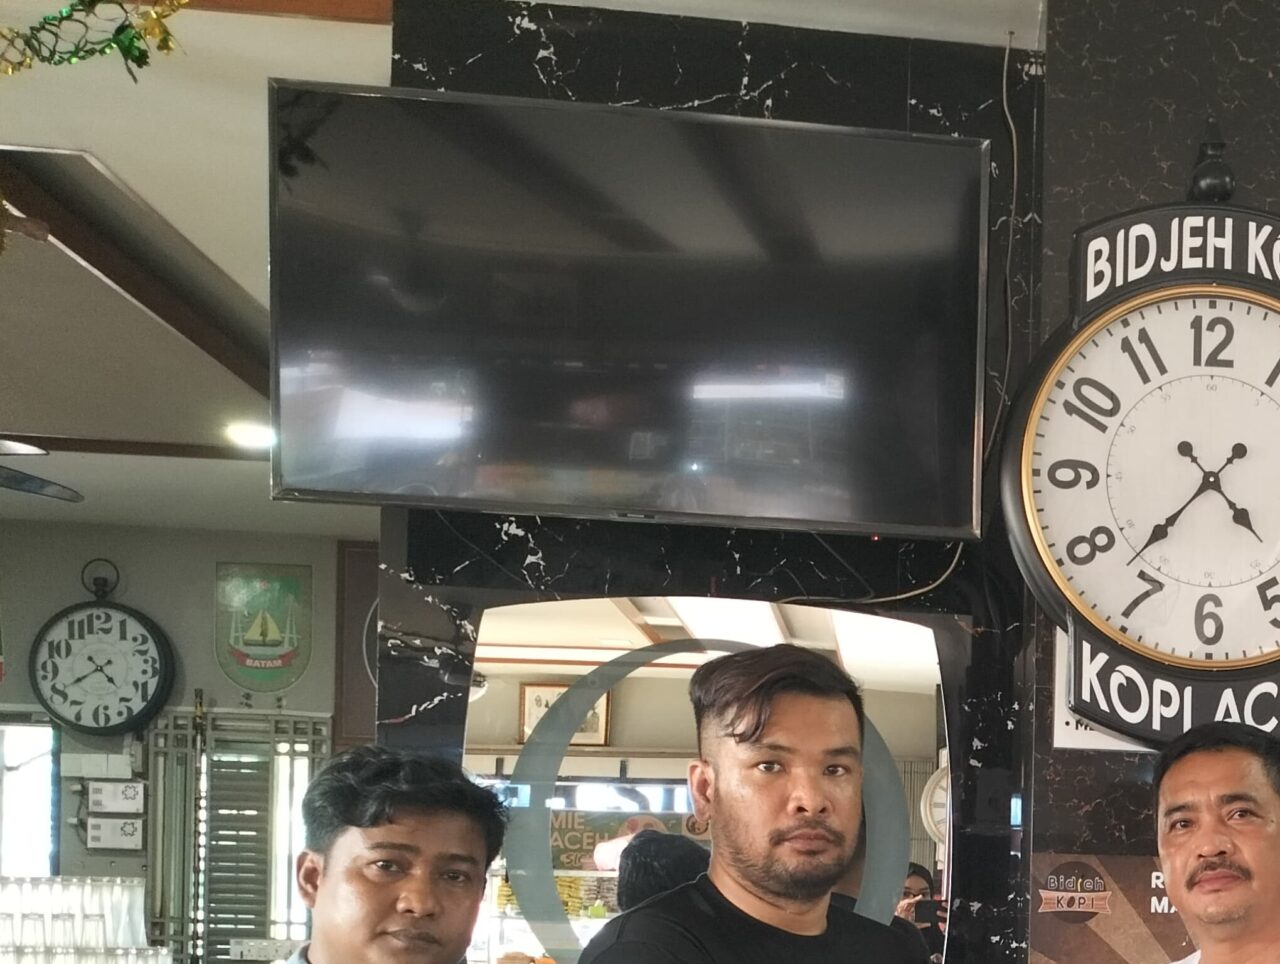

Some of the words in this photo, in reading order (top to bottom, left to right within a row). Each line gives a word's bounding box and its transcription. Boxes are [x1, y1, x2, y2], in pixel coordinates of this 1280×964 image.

[1086, 216, 1233, 302] BIDJEH
[1190, 315, 1234, 368] 12
[1120, 327, 1168, 385] 11
[1063, 377, 1121, 434] 10
[1047, 459, 1100, 489] 9
[1066, 525, 1116, 566] 8
[1121, 569, 1165, 619] 7
[68, 618, 86, 640] 11
[86, 612, 113, 635] 12
[119, 618, 127, 641] 1
[1194, 593, 1223, 646] 6
[48, 639, 72, 659] 10
[132, 634, 149, 656] 2
[41, 660, 59, 681] 9
[142, 656, 159, 679] 3
[245, 659, 282, 668] BATAM
[50, 682, 69, 705] 8
[1081, 640, 1193, 733] KOPI
[92, 704, 111, 726] 6
[551, 812, 585, 829] MIE
[1056, 895, 1095, 909] KOPI
